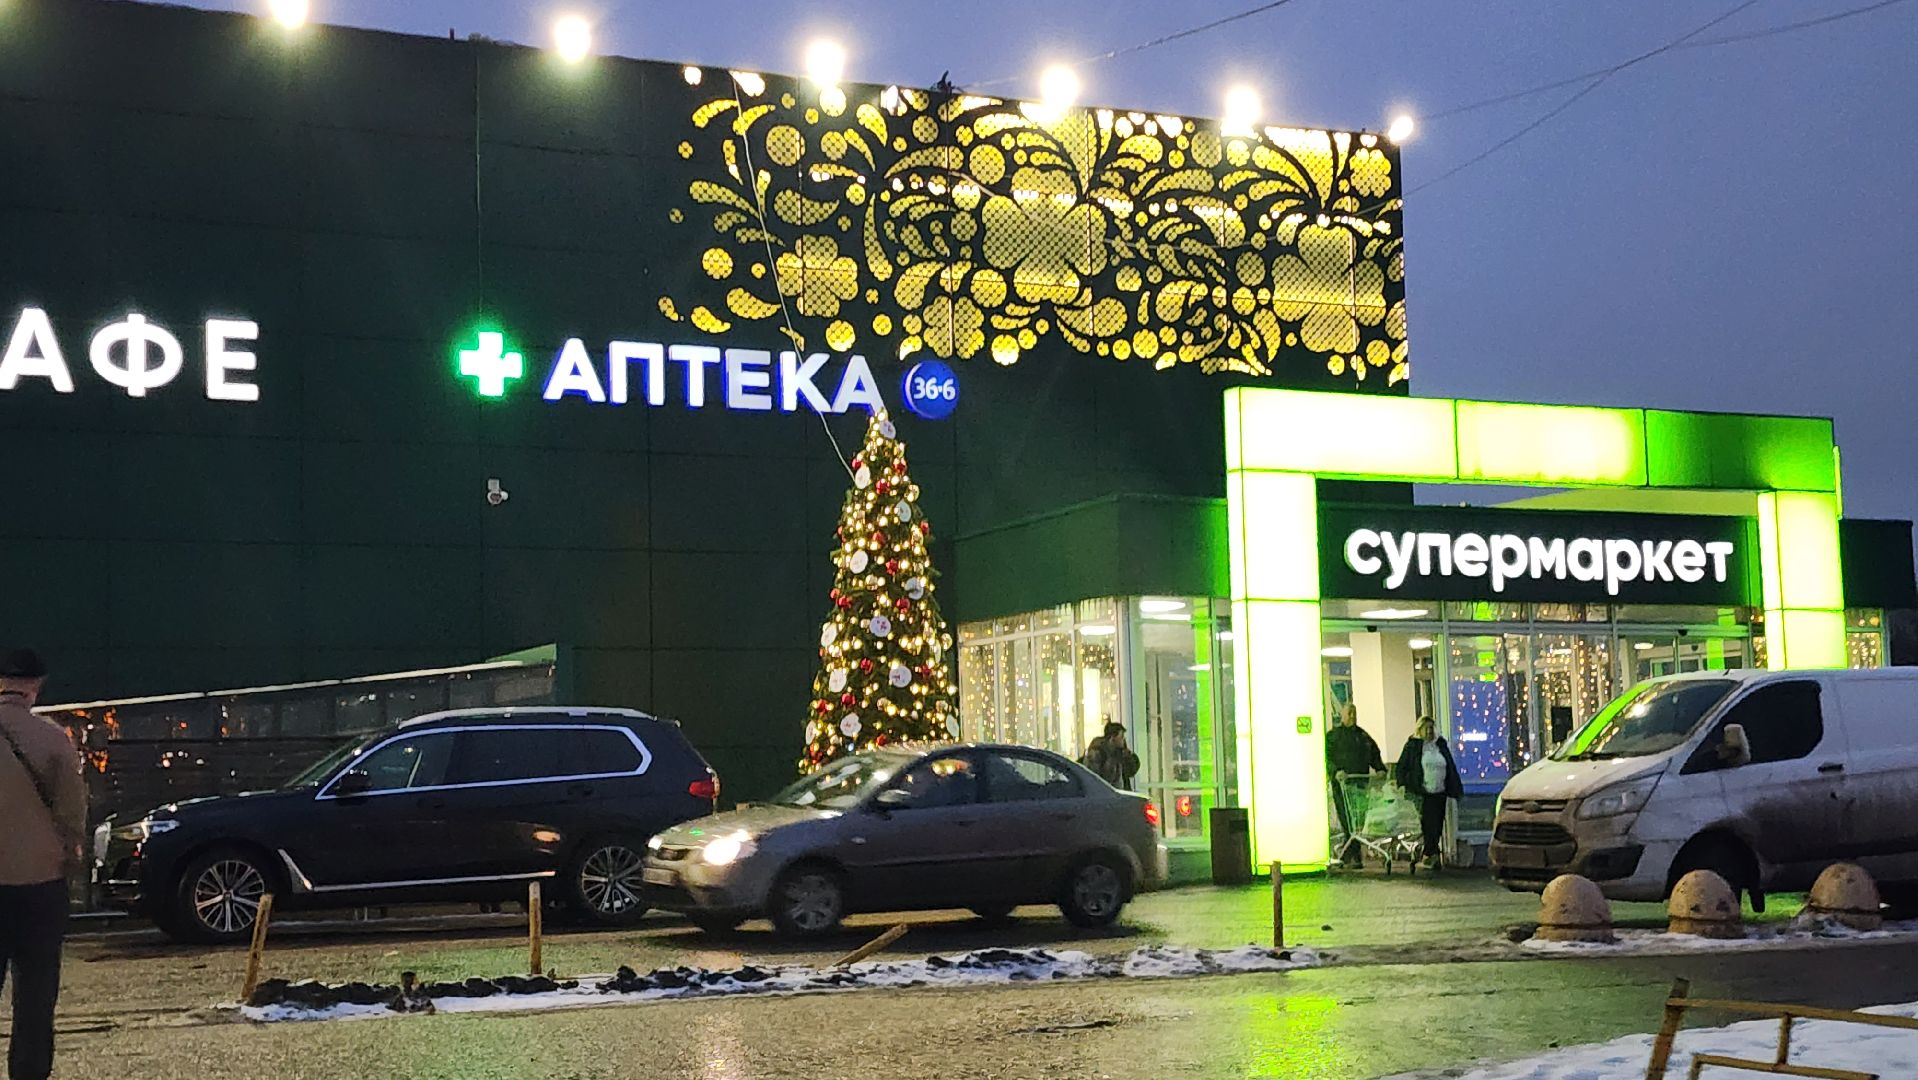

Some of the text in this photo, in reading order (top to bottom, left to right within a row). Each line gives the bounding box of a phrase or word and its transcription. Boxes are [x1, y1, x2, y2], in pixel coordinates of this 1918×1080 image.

[0, 307, 260, 401] АФЕ
[543, 337, 887, 415] АПТЕКА
[1344, 528, 1734, 596] супермаркет
